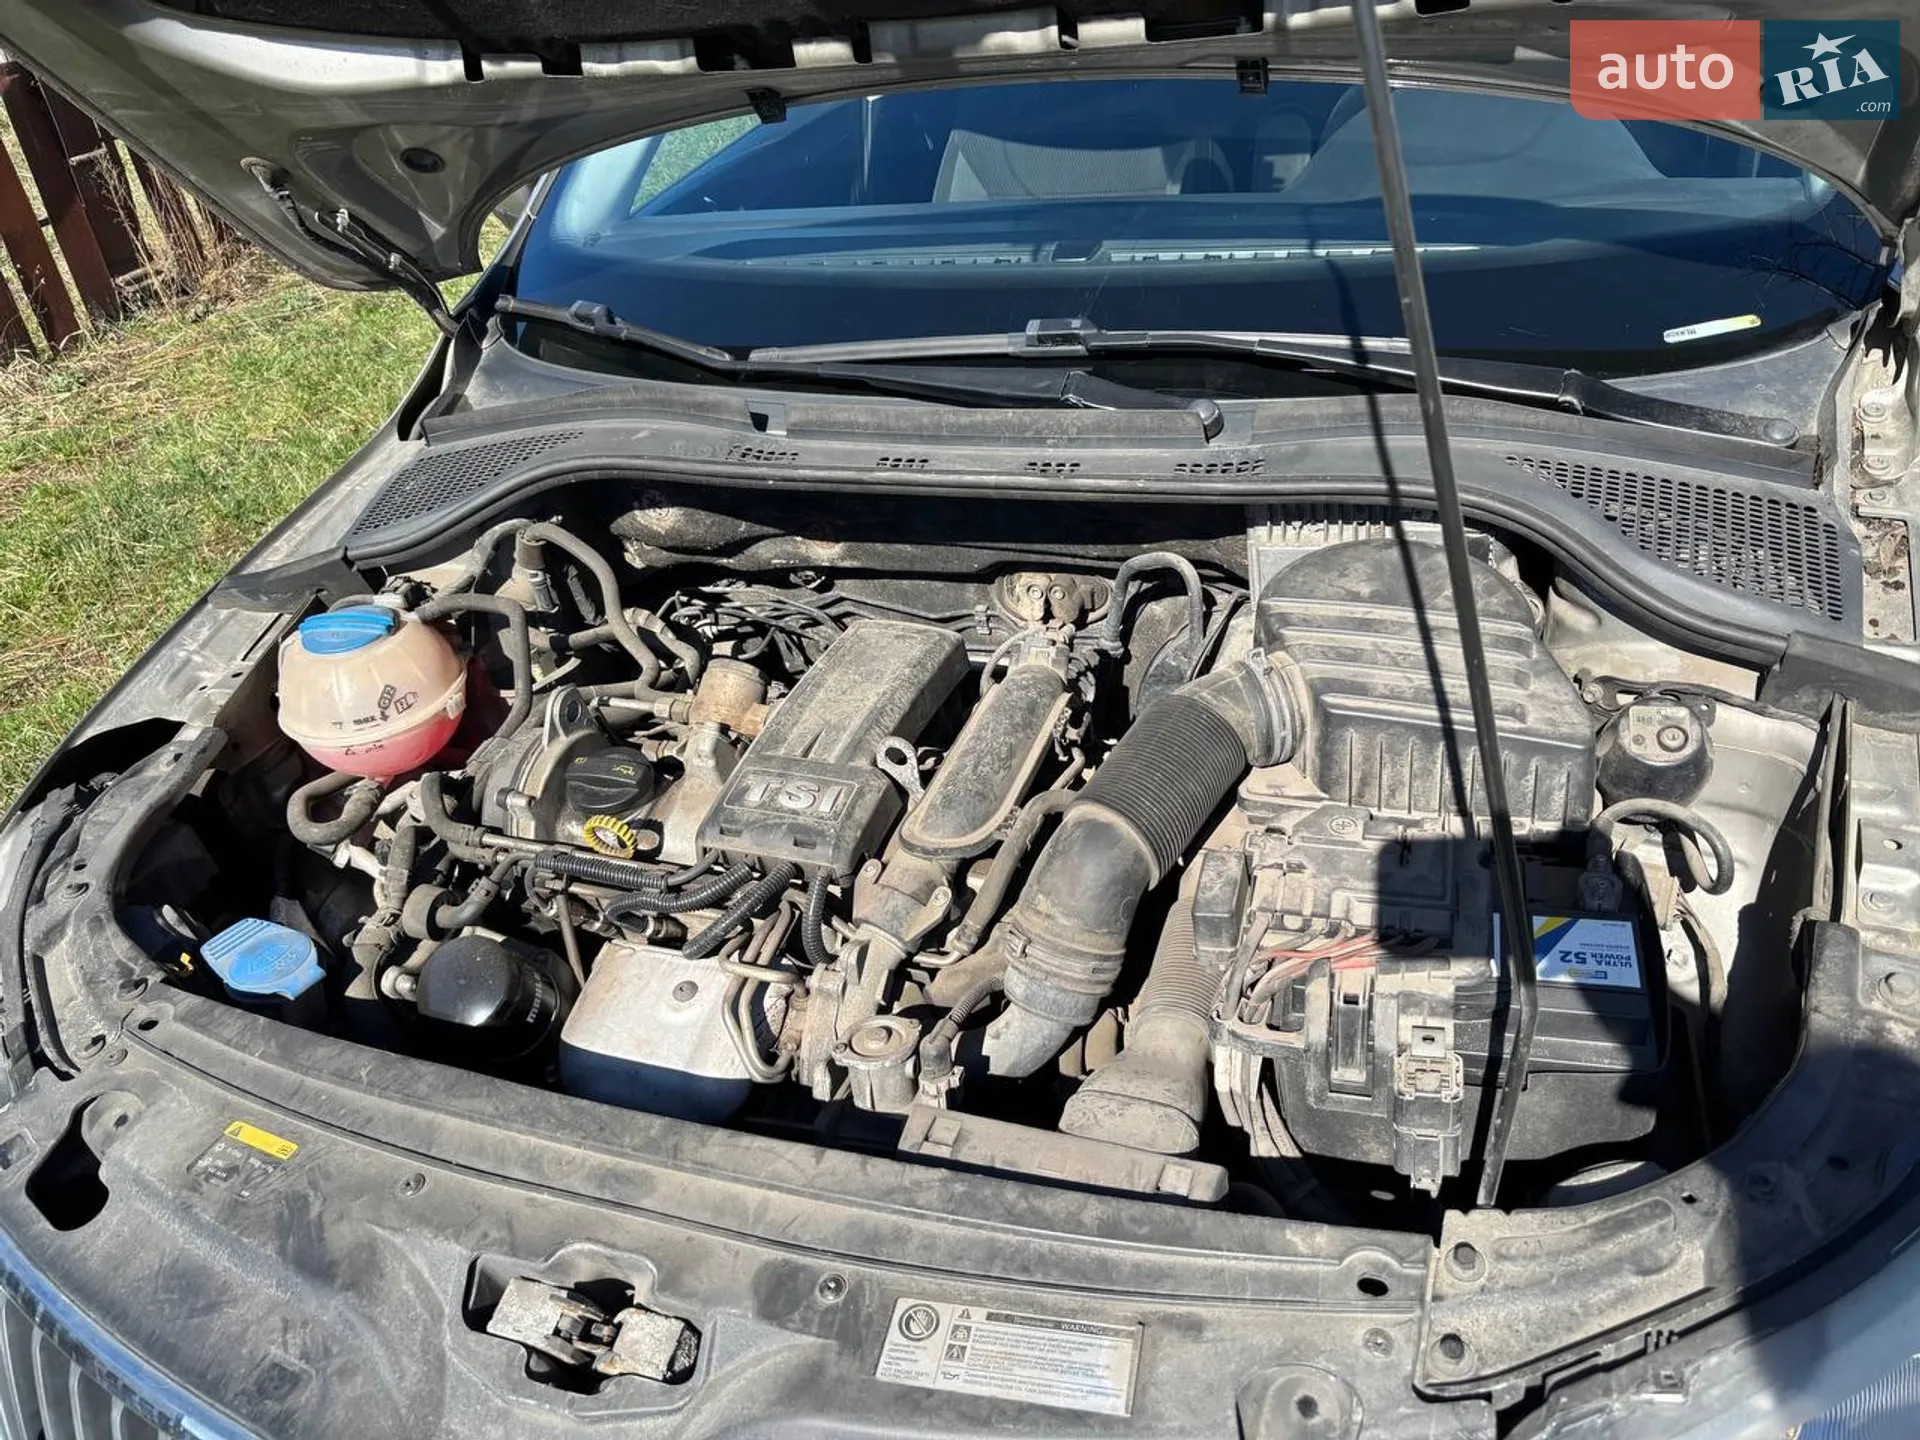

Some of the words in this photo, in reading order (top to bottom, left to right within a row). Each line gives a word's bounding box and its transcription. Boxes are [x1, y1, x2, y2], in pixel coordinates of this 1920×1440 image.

[742, 777, 844, 813] TSI
[1559, 949, 1588, 965] 52
[1589, 951, 1632, 962] POWER
[1595, 959, 1633, 969] ULTRA
[1060, 1321, 1105, 1335] WARNING
